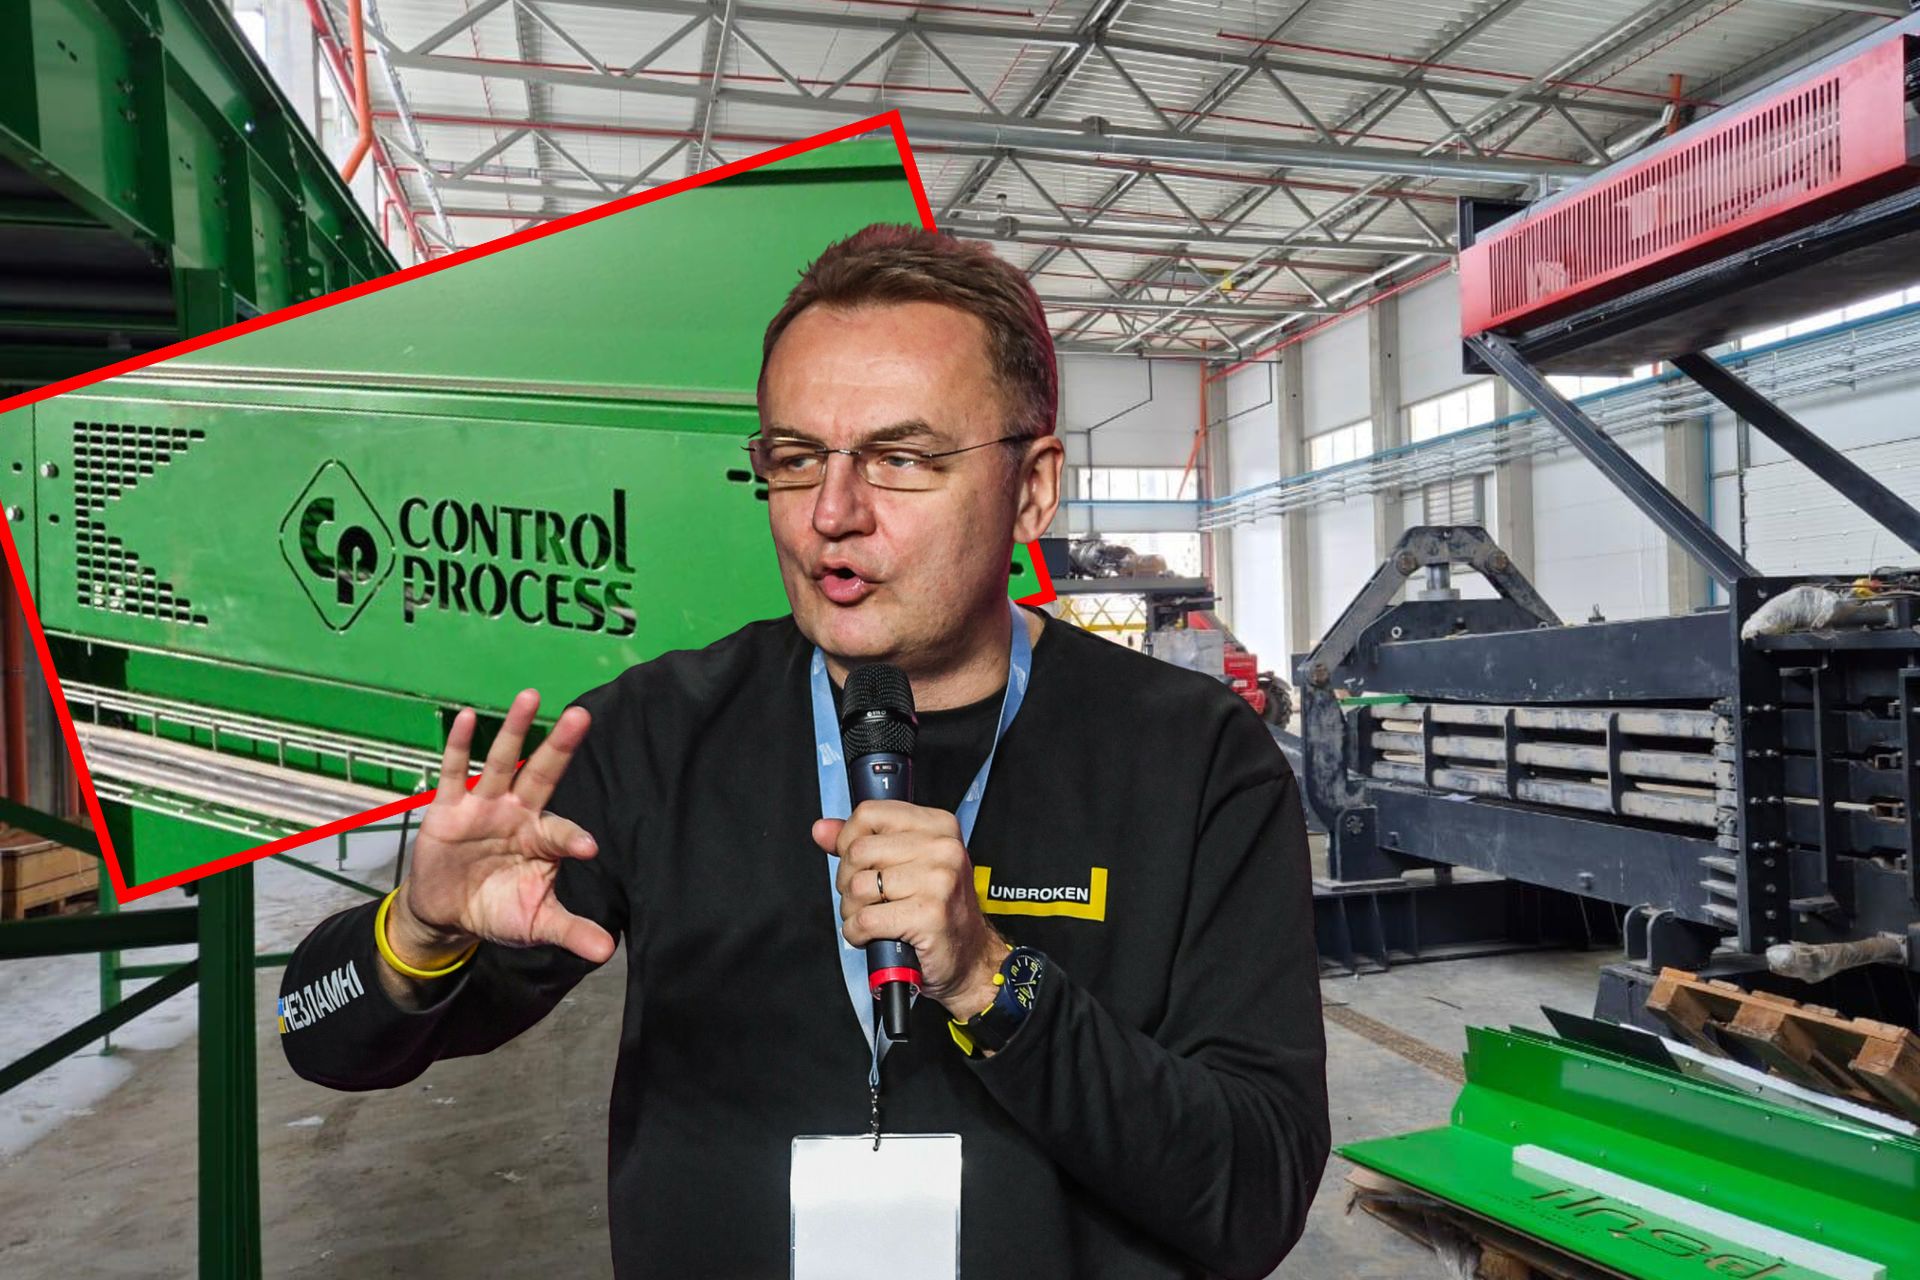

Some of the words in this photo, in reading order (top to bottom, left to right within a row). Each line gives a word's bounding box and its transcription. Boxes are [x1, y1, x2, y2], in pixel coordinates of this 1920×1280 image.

[881, 776, 889, 790] 1
[990, 885, 1089, 902] UNBROKEN
[283, 960, 364, 1032] НЕЗЛАМНІ
